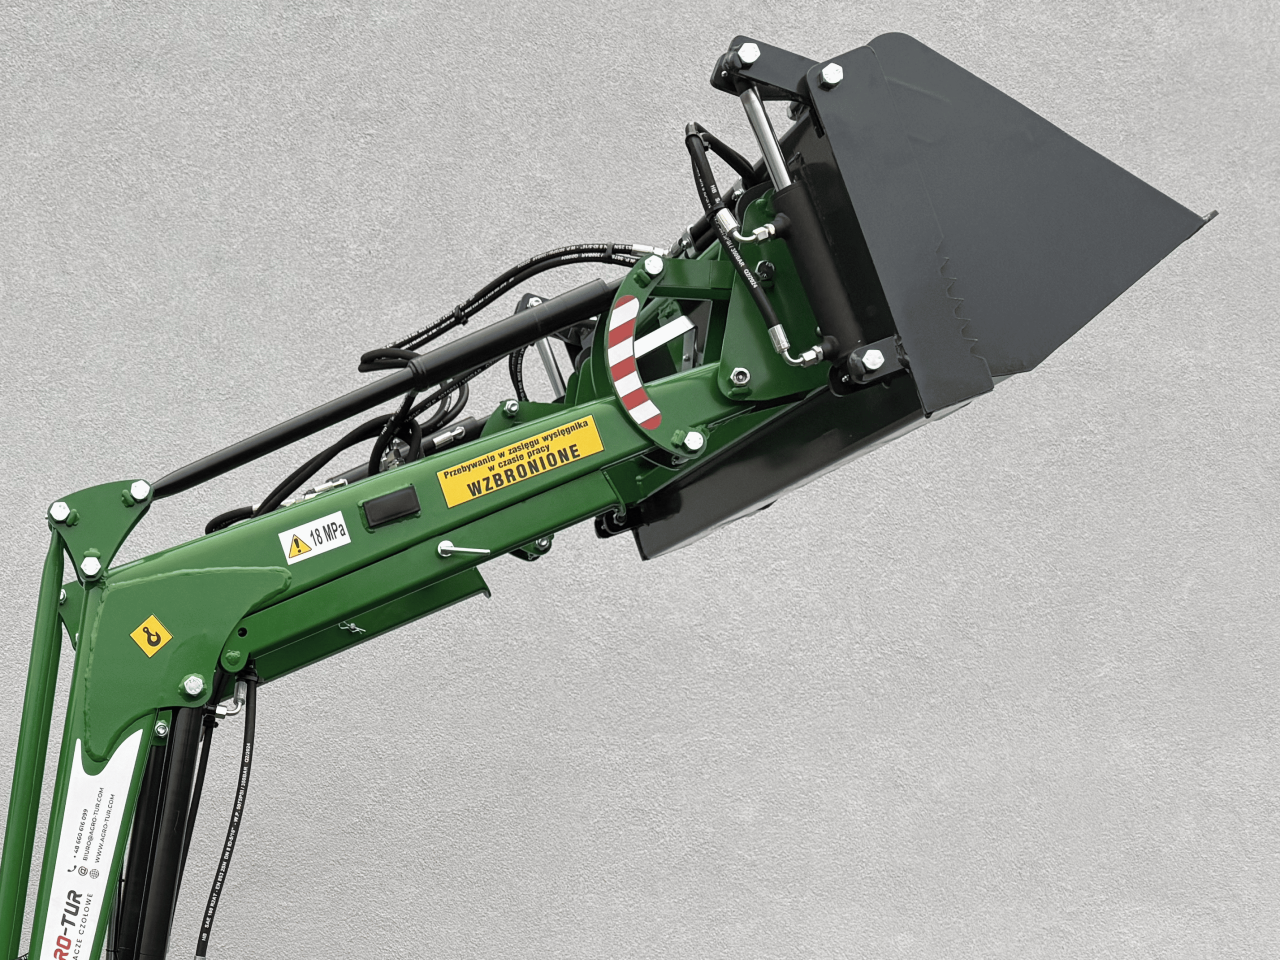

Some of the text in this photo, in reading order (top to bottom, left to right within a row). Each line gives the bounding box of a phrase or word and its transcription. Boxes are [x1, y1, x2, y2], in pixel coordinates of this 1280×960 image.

[444, 454, 496, 480] Przebywanie
[498, 454, 525, 468] czasie
[527, 444, 550, 461] pracy
[467, 444, 581, 497] WZBRONIONE
[310, 522, 346, 546] 18 MPa
[95, 794, 115, 863] WWW.AGRO-TUR.COM
